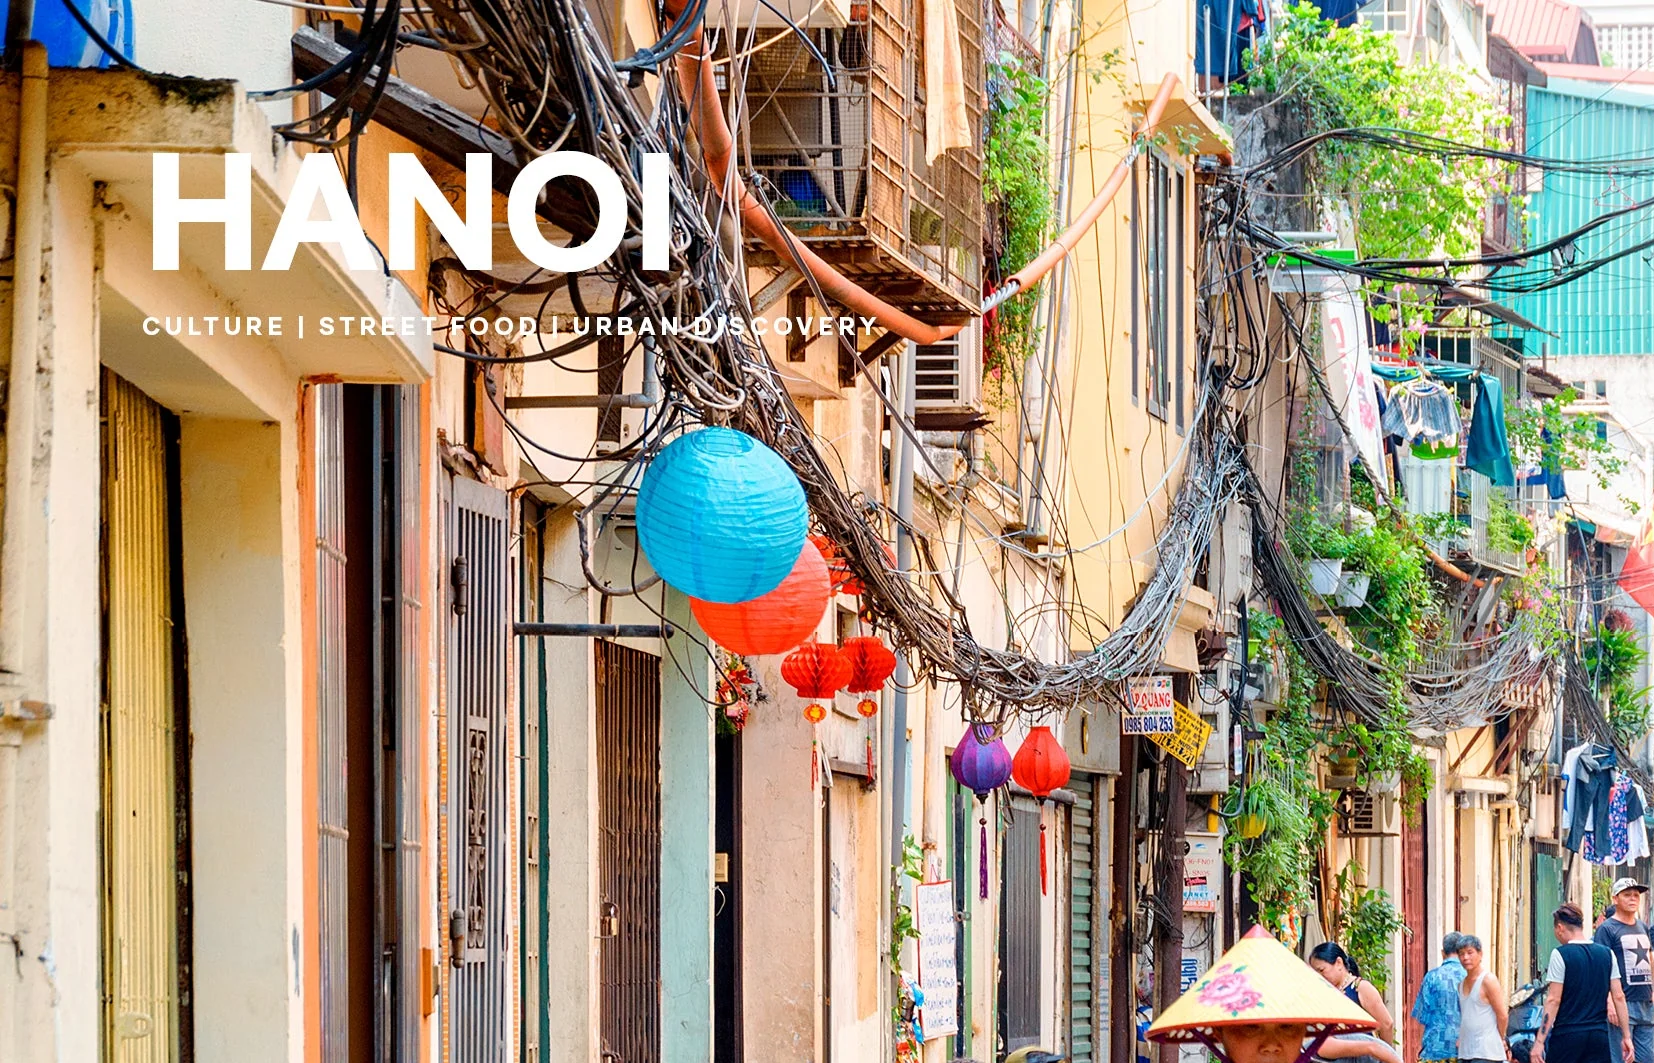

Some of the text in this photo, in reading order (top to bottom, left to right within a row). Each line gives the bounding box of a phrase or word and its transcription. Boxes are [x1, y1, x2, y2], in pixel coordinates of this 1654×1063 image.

[1141, 692, 1171, 711] QUANG
[1124, 716, 1174, 733] 0985 804 253
